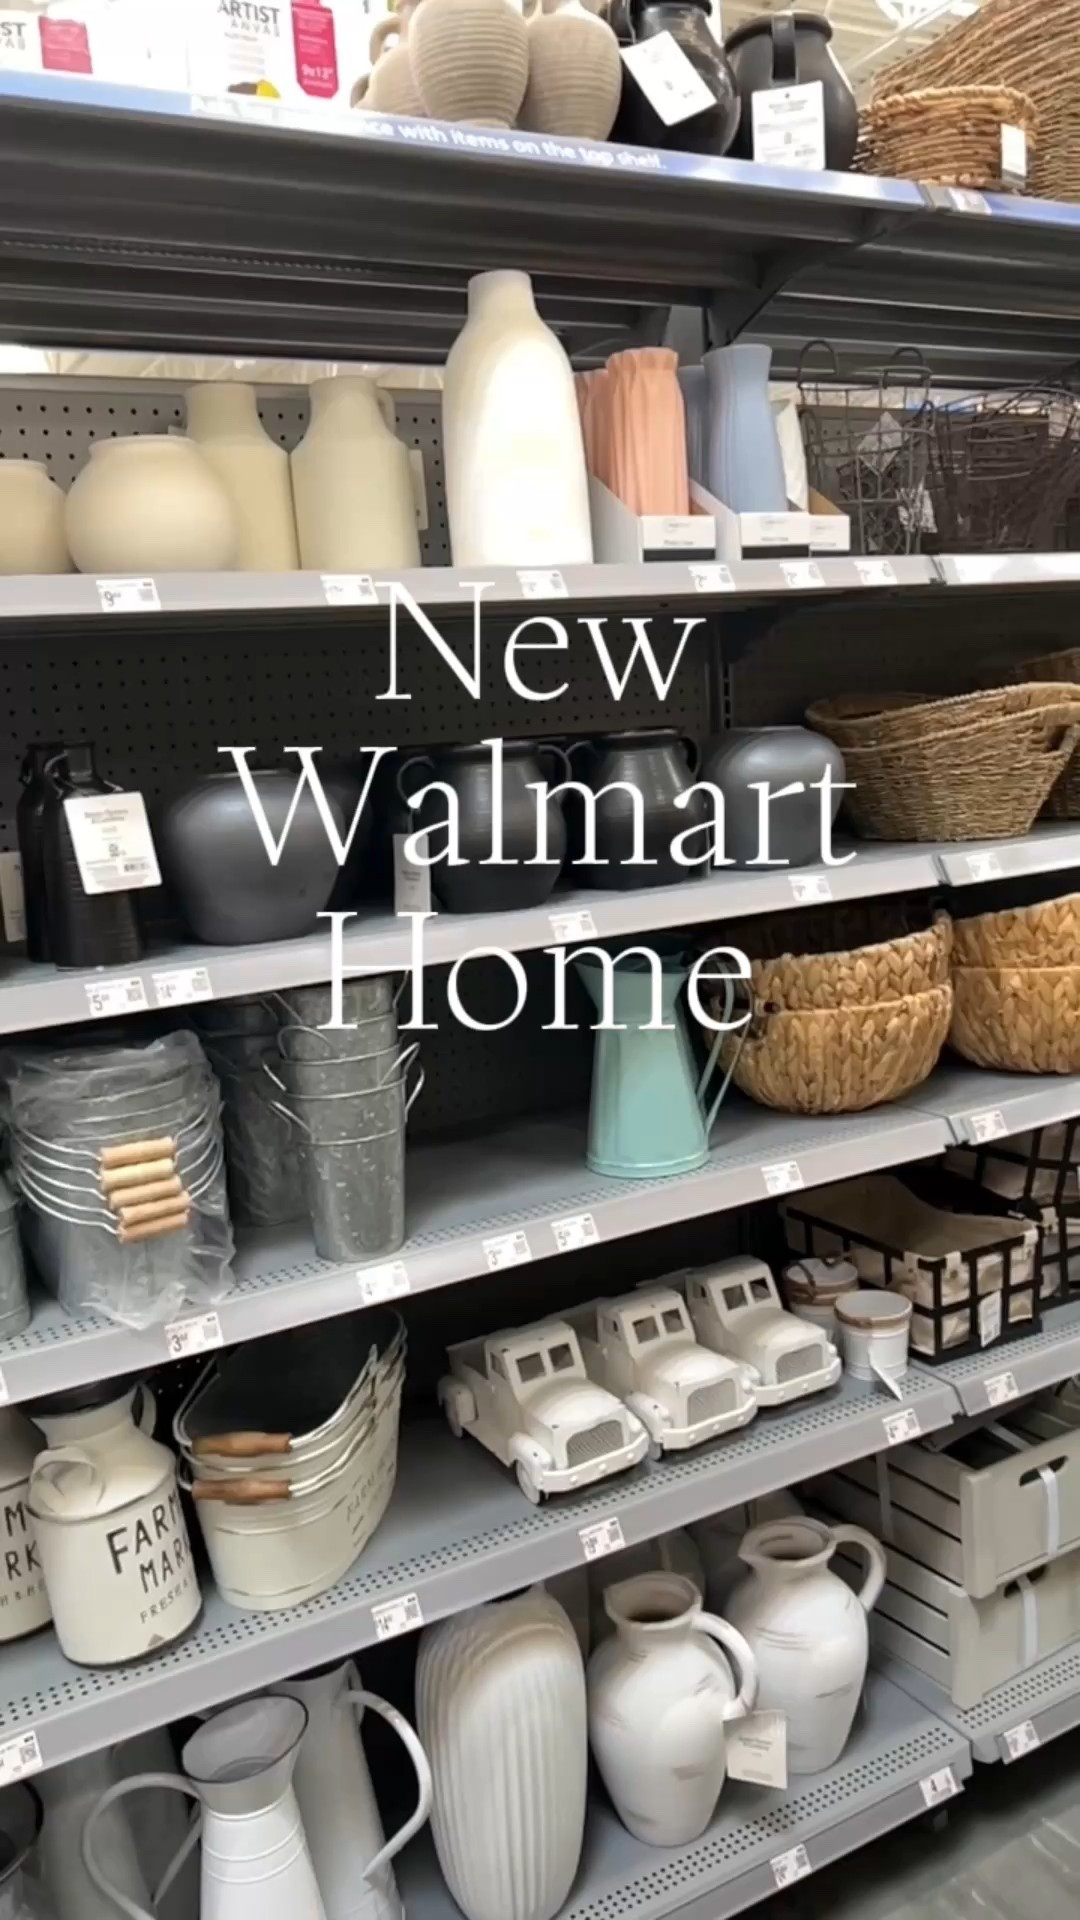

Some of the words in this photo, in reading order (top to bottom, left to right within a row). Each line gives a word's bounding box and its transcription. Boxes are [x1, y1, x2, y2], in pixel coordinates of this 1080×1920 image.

[217, 0, 280, 24] ARTIST
[398, 124, 448, 143] with
[450, 128, 509, 151] items
[512, 139, 540, 155] on
[541, 140, 577, 159] the
[578, 145, 615, 168] top
